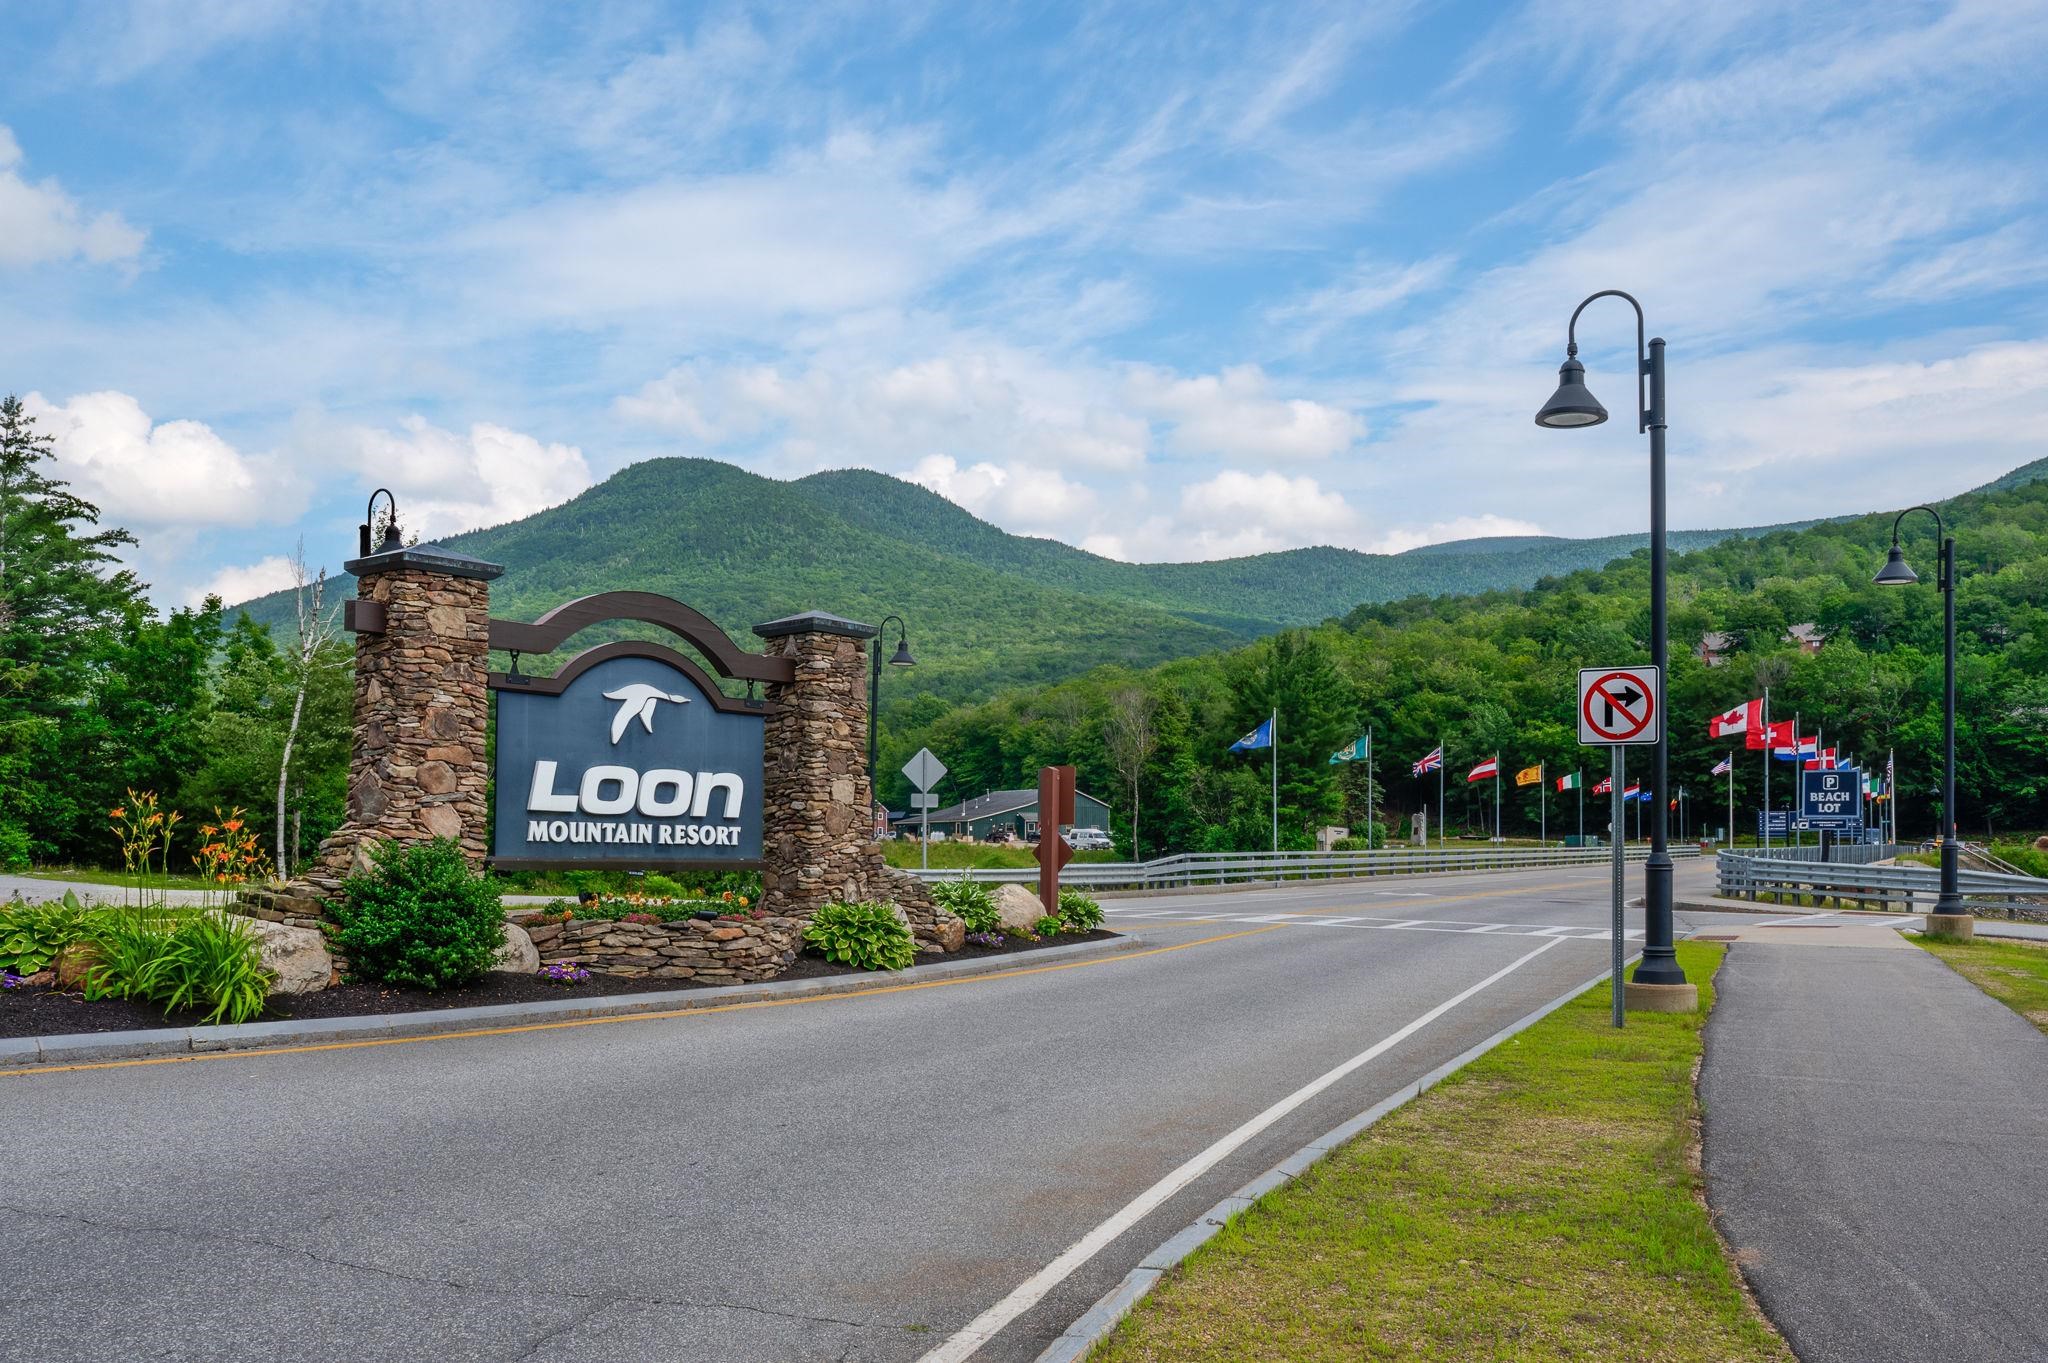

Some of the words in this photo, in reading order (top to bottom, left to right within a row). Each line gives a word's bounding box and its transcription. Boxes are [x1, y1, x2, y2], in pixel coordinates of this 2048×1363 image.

[1826, 777, 1835, 788] P
[1810, 791, 1850, 802] BEACH
[1818, 803, 1841, 813] LOT
[526, 820, 653, 844] MOUNTAIN
[657, 824, 742, 846] RESORT
